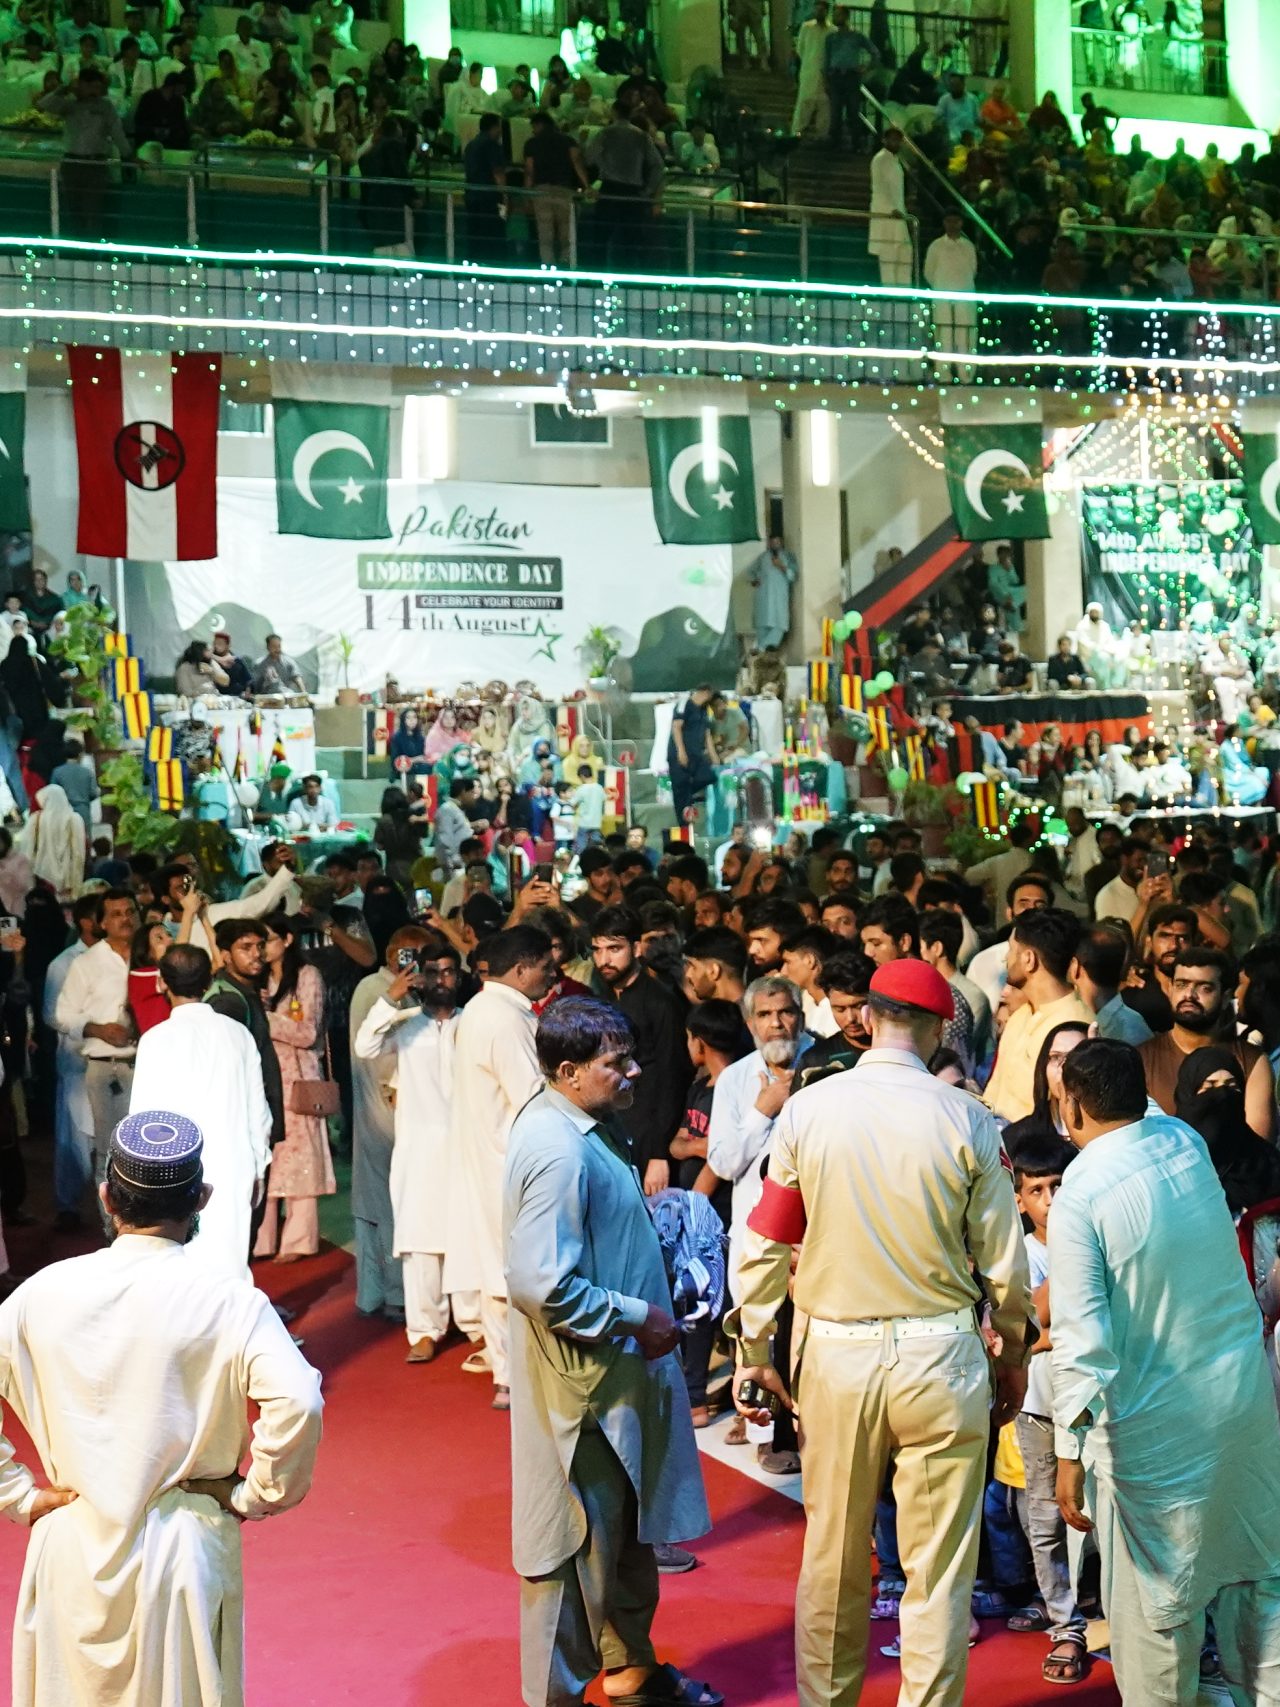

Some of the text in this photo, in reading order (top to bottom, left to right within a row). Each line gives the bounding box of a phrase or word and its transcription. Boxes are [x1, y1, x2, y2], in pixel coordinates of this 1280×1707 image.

[398, 504, 533, 546] Pakistan
[366, 561, 556, 585] INDEPENDENCE DAY
[420, 596, 558, 608] CELEBRATE YOUR IDENTITY
[450, 612, 531, 635] August
